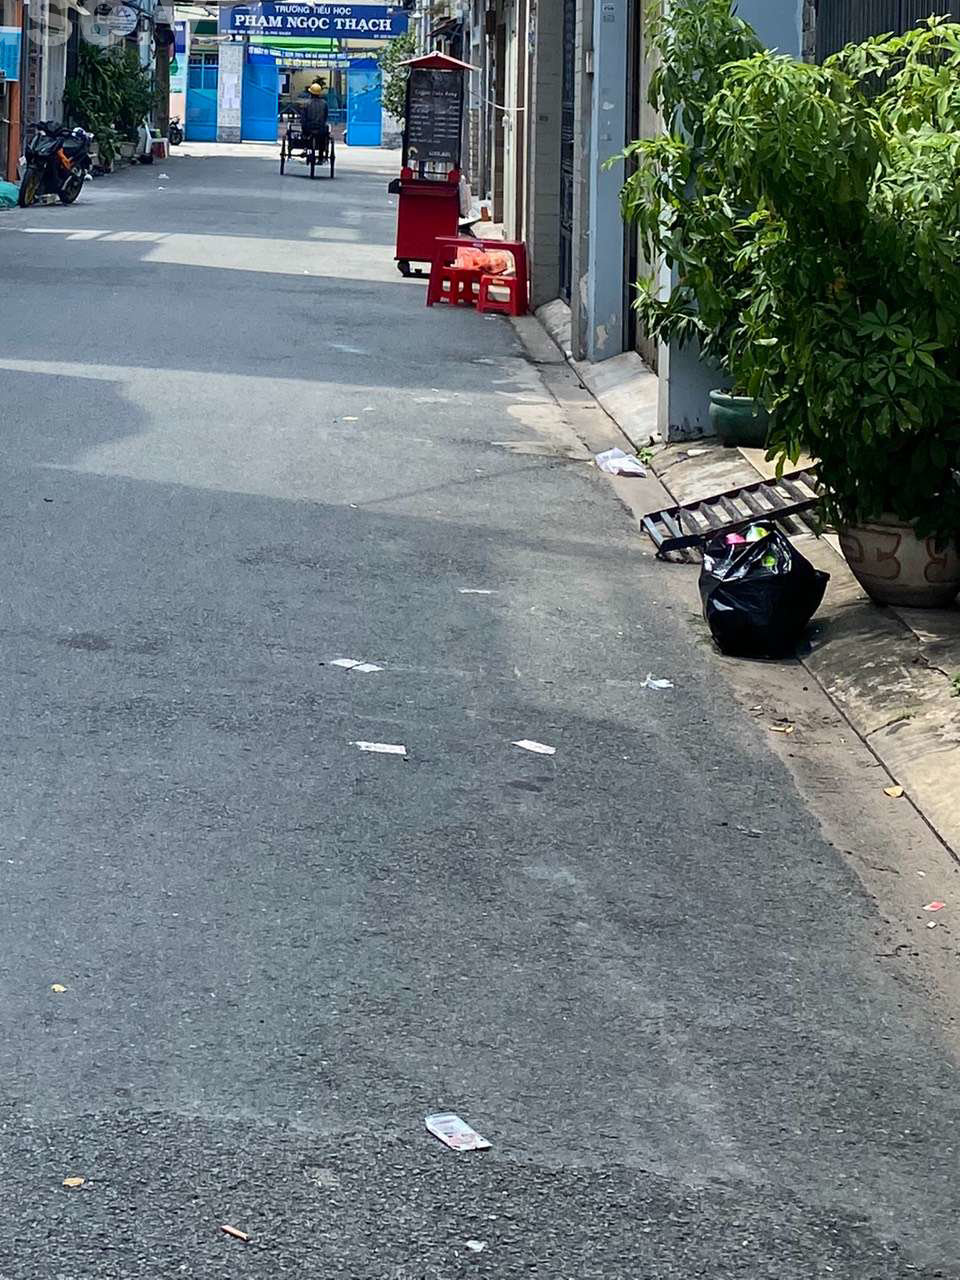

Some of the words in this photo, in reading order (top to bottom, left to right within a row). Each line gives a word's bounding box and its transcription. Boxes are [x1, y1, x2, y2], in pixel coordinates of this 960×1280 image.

[333, 7, 352, 16] HỌC
[234, 15, 283, 29] PHẠM
[286, 16, 330, 31] NGỌC
[333, 18, 392, 32] THẠCH
